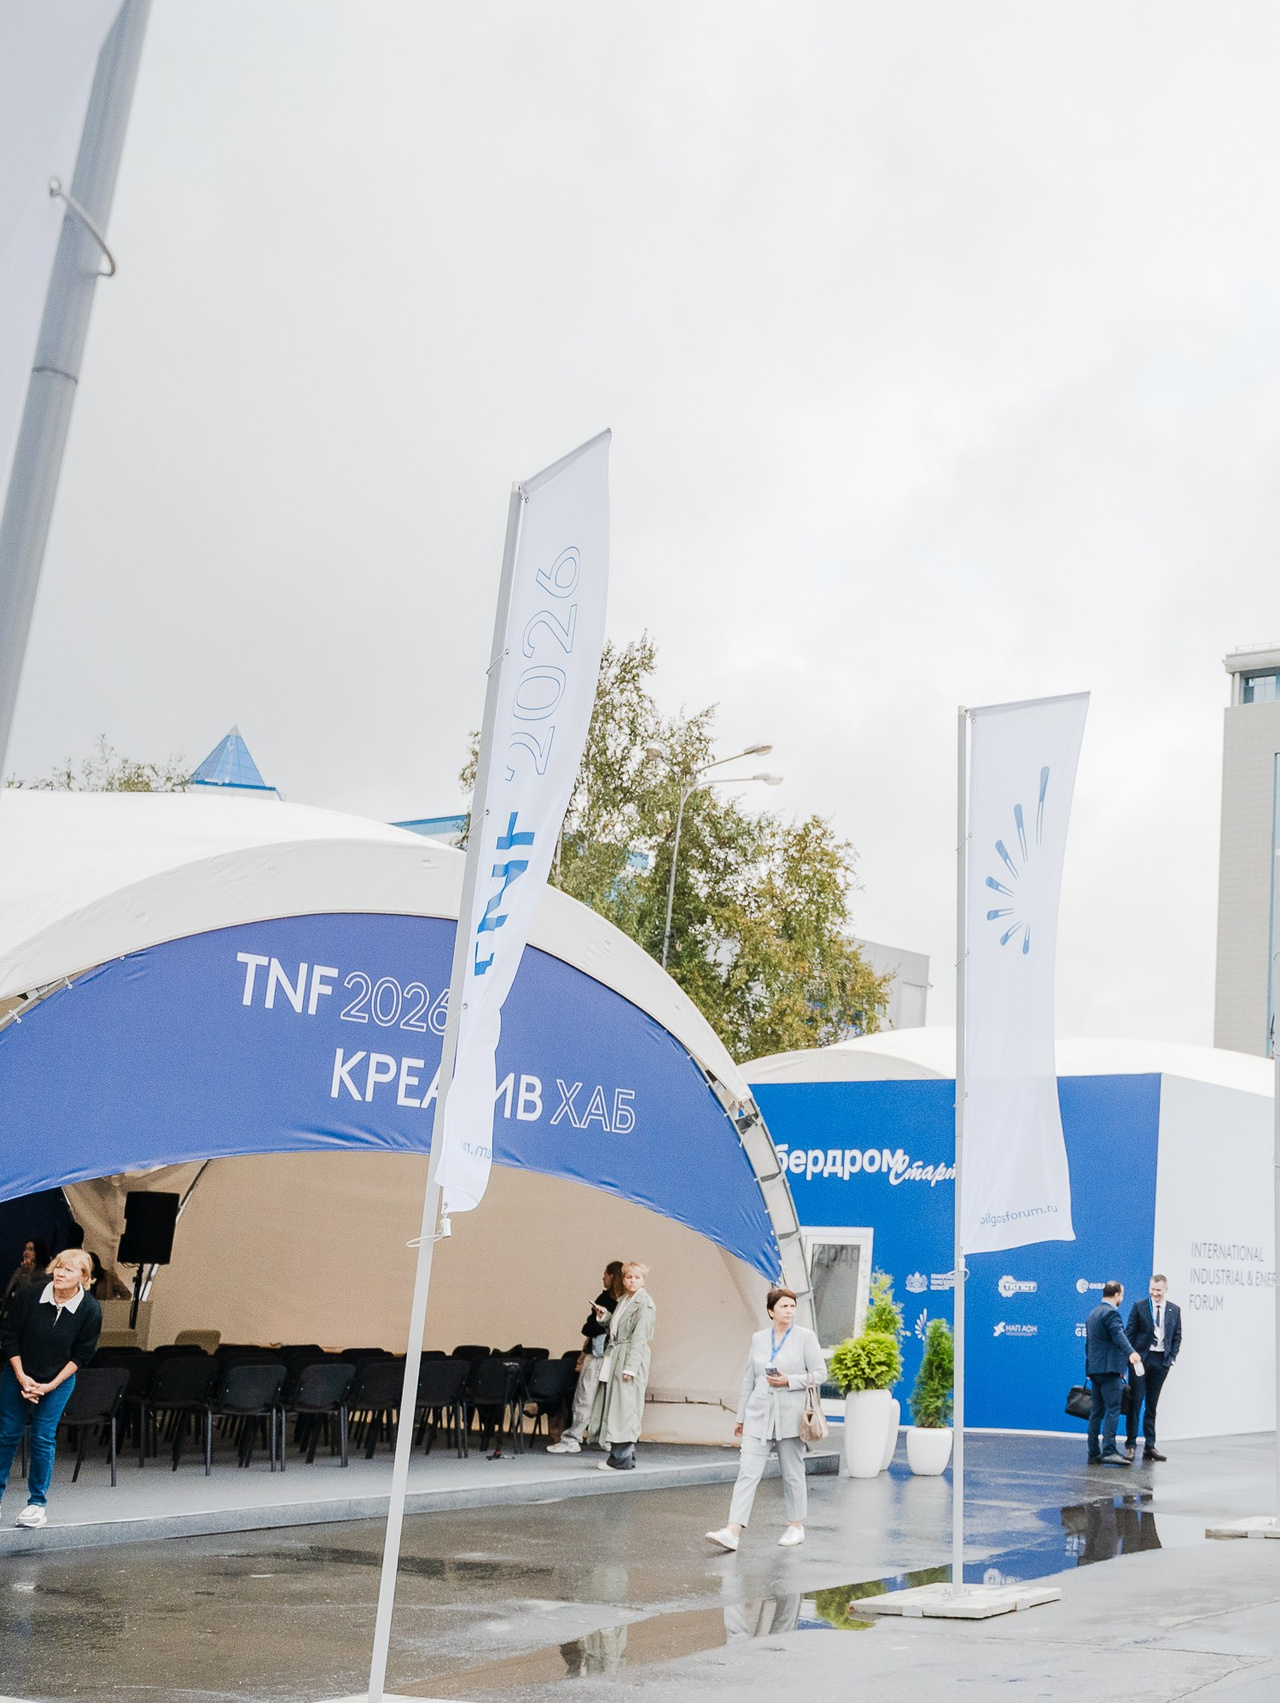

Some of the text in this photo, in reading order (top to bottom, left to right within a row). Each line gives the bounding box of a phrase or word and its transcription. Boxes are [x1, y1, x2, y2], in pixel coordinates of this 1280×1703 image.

[504, 545, 582, 782] 2026
[236, 952, 450, 1037] TNF 2026
[330, 1047, 637, 1135] КРЕИВ ХАБ
[776, 1143, 905, 1181] бердром
[979, 1203, 1059, 1228] oilgasforum.ru
[1191, 1241, 1264, 1263] INTERNATIONAL
[1190, 1267, 1246, 1287] INDUSTRIAL
[1247, 1269, 1253, 1287] &
[1188, 1294, 1224, 1311] FORUM
